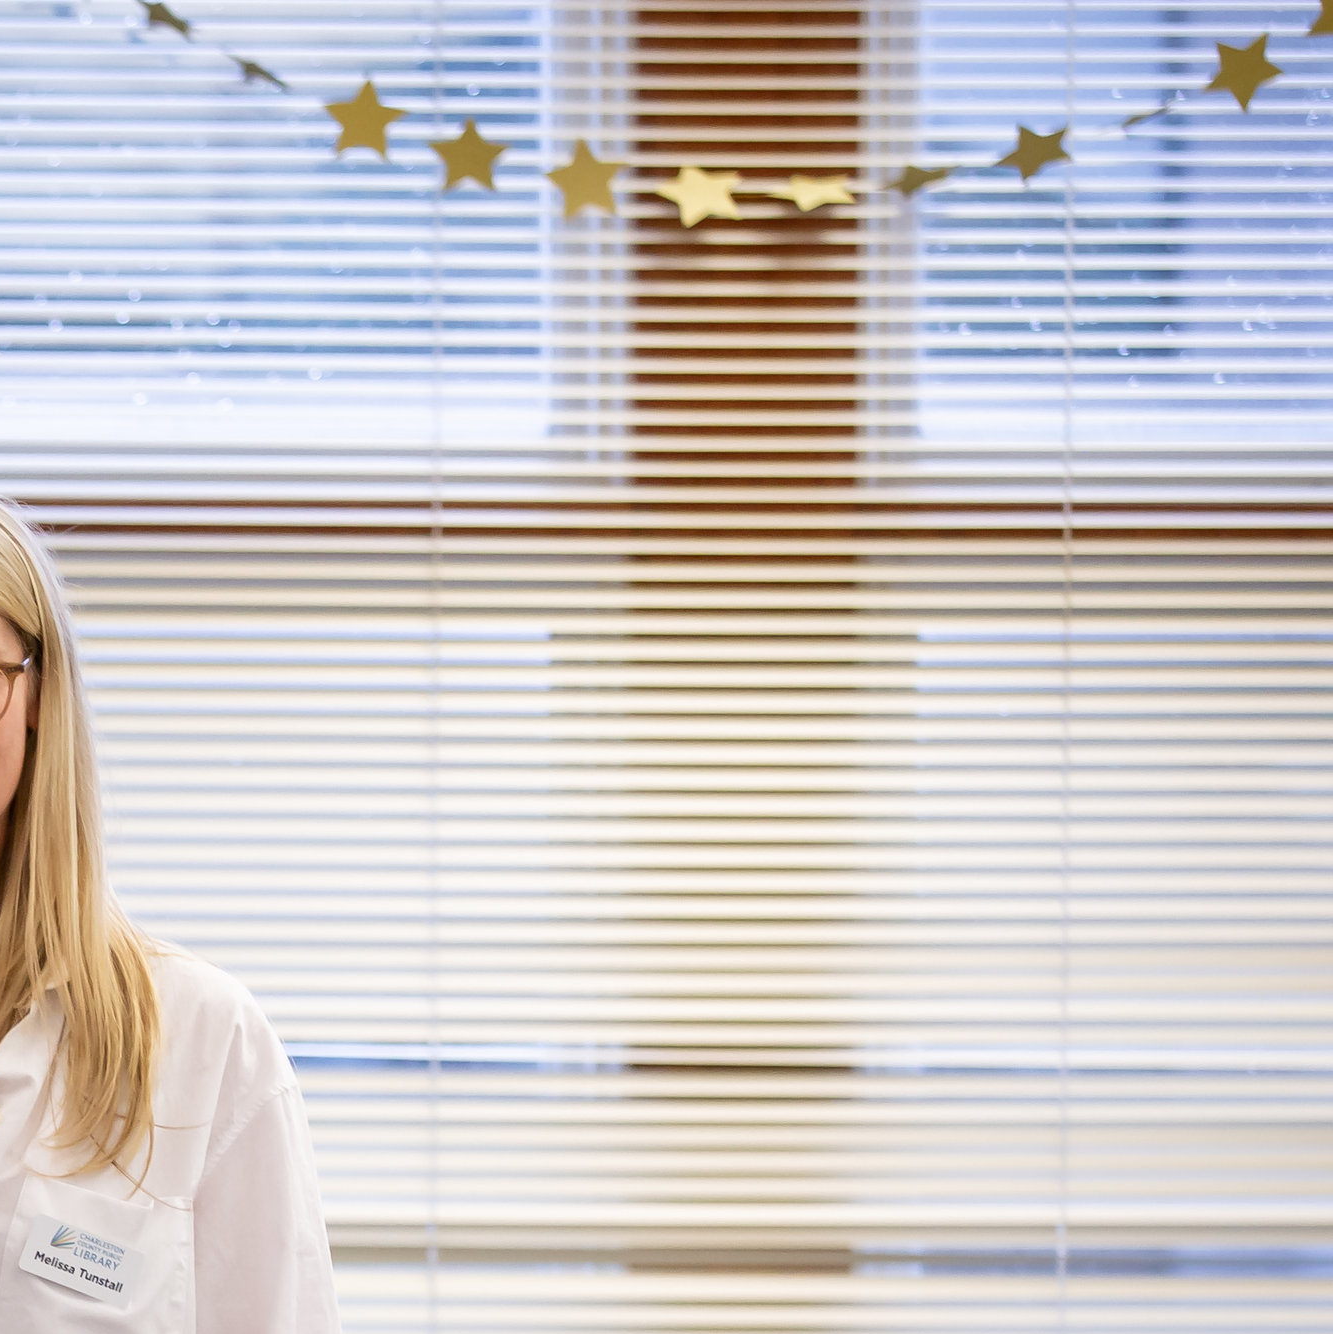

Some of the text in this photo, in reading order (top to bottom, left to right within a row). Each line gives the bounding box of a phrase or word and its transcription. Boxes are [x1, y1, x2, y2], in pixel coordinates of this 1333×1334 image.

[76, 1239, 123, 1262] COUNTY PUBLIC
[79, 1233, 125, 1254] CHARLESTON
[73, 1247, 120, 1271] LIBRARY
[34, 1250, 123, 1293] Melissa Tunstall
